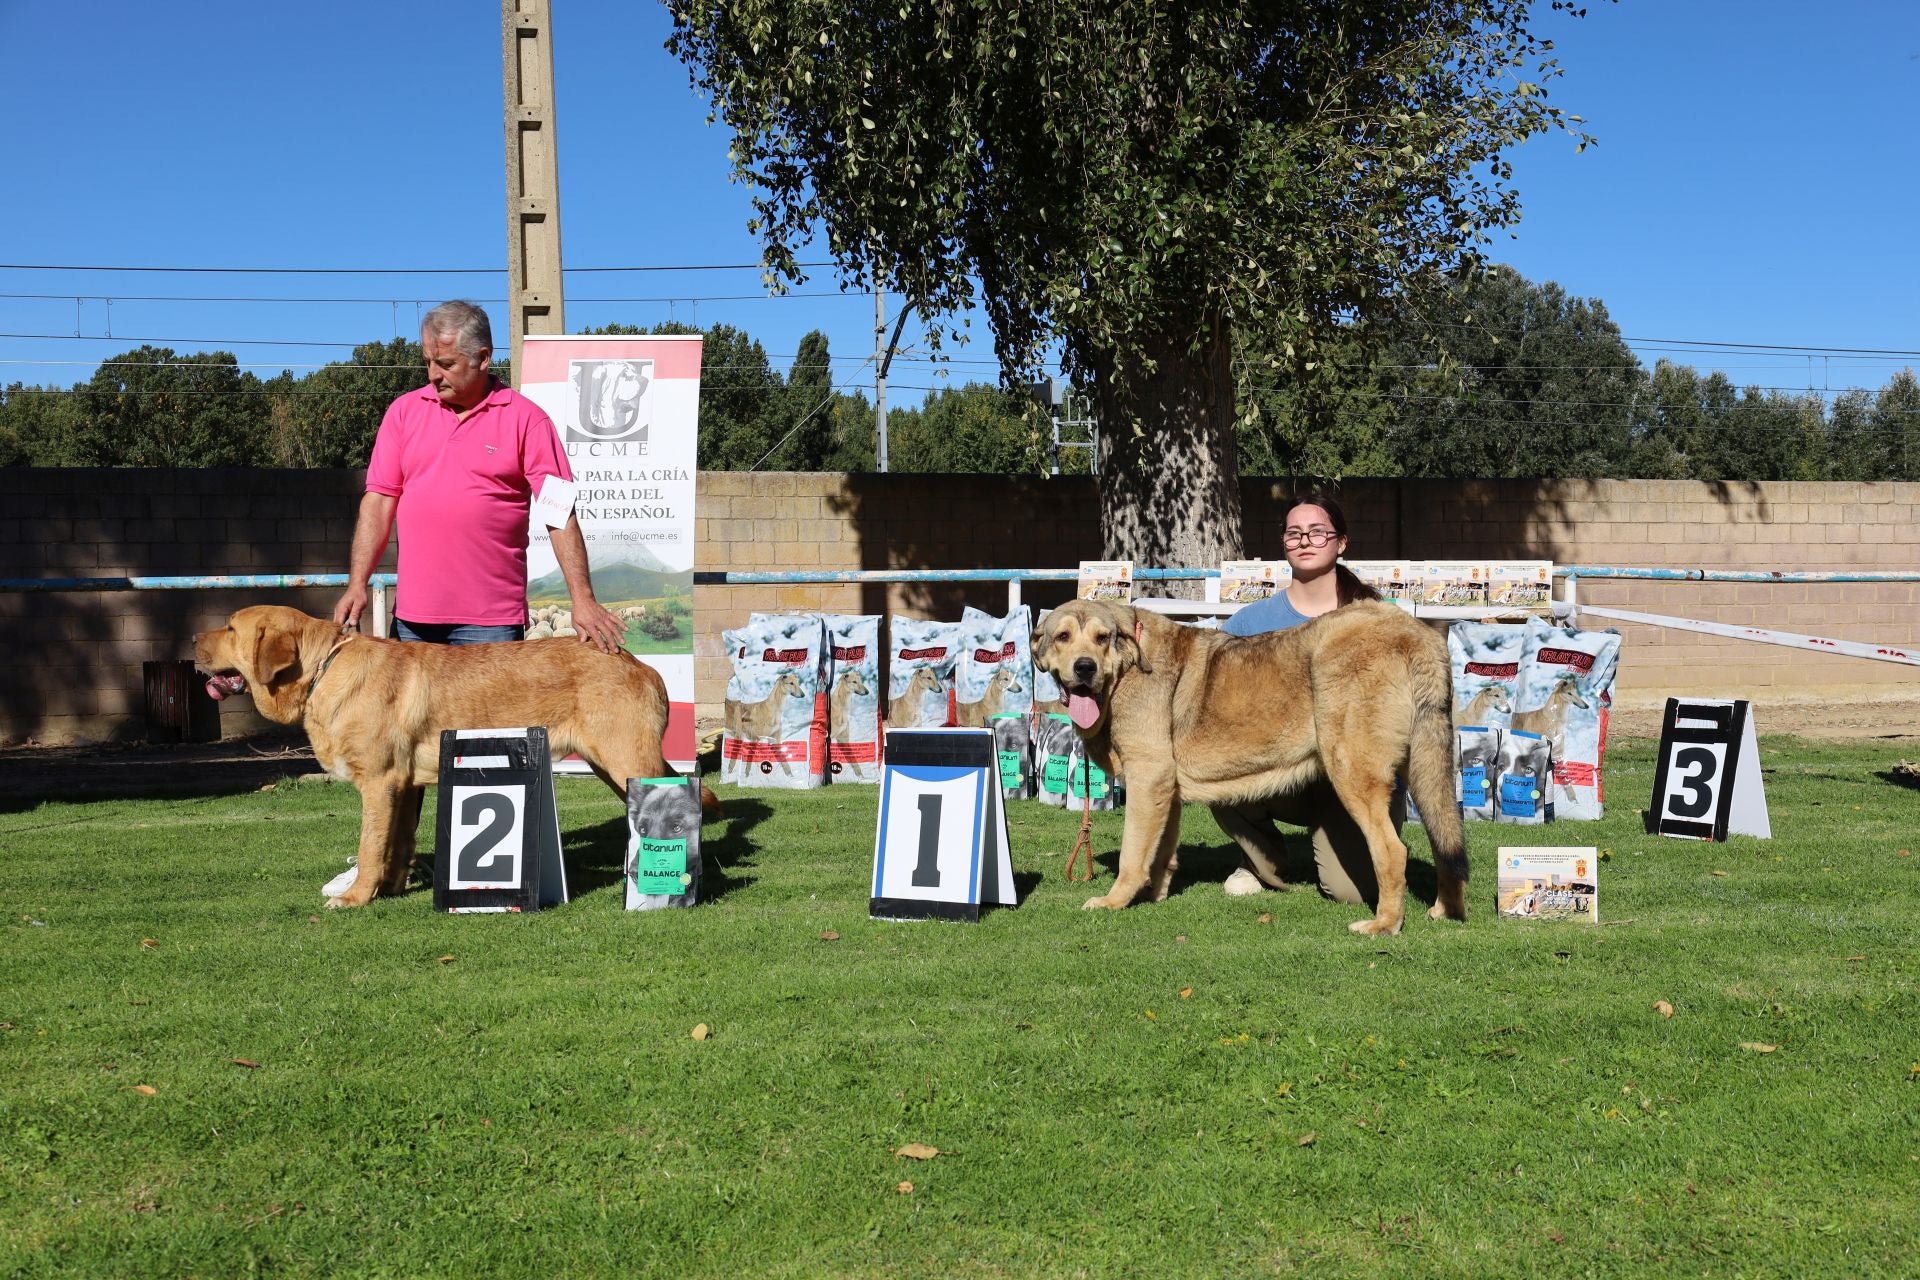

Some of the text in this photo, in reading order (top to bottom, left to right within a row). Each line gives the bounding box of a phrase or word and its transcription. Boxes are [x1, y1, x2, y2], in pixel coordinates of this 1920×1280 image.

[566, 442, 649, 457] UCME
[585, 471, 624, 482] PARA
[628, 471, 647, 481] LA
[651, 468, 689, 482] CRÍA
[576, 488, 664, 503] EJORA DEL
[602, 504, 675, 520] ESPAÑOL
[610, 530, 679, 543] info@ucme.es
[1504, 777, 1534, 787] titanium
[1668, 747, 1717, 818] 3
[457, 792, 515, 882] 2
[911, 793, 943, 888] 1
[642, 841, 683, 853] titanium
[643, 870, 681, 878] BALANCE
[1546, 890, 1573, 898] CLASE
